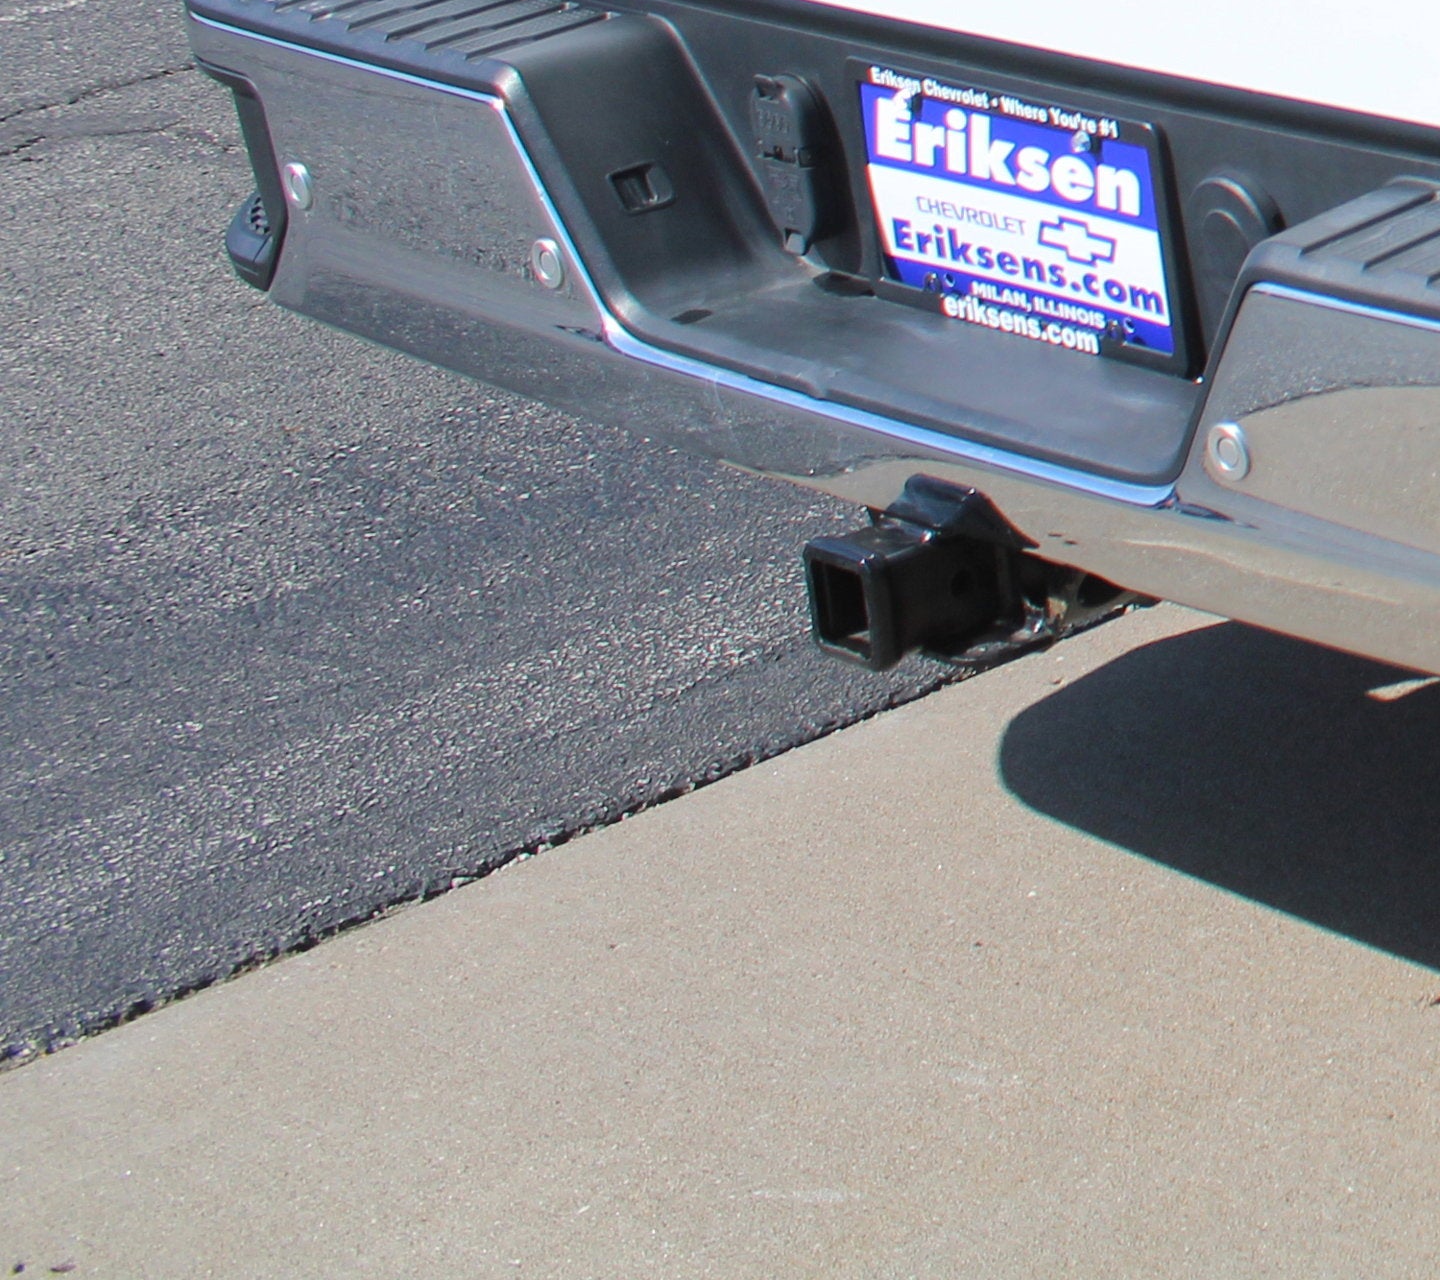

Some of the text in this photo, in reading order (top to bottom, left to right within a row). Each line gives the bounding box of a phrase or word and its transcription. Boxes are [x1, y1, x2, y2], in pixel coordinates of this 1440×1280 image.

[868, 66, 1119, 139] Eriksen Chevrolet Where You're #1
[875, 97, 1141, 217] Eriksen
[916, 196, 1026, 235] CHEVROLET
[892, 217, 1165, 316] Eriksens.com
[942, 293, 1099, 355] eriksens.com
[969, 281, 1106, 329] MILAN, ILLINOIS
